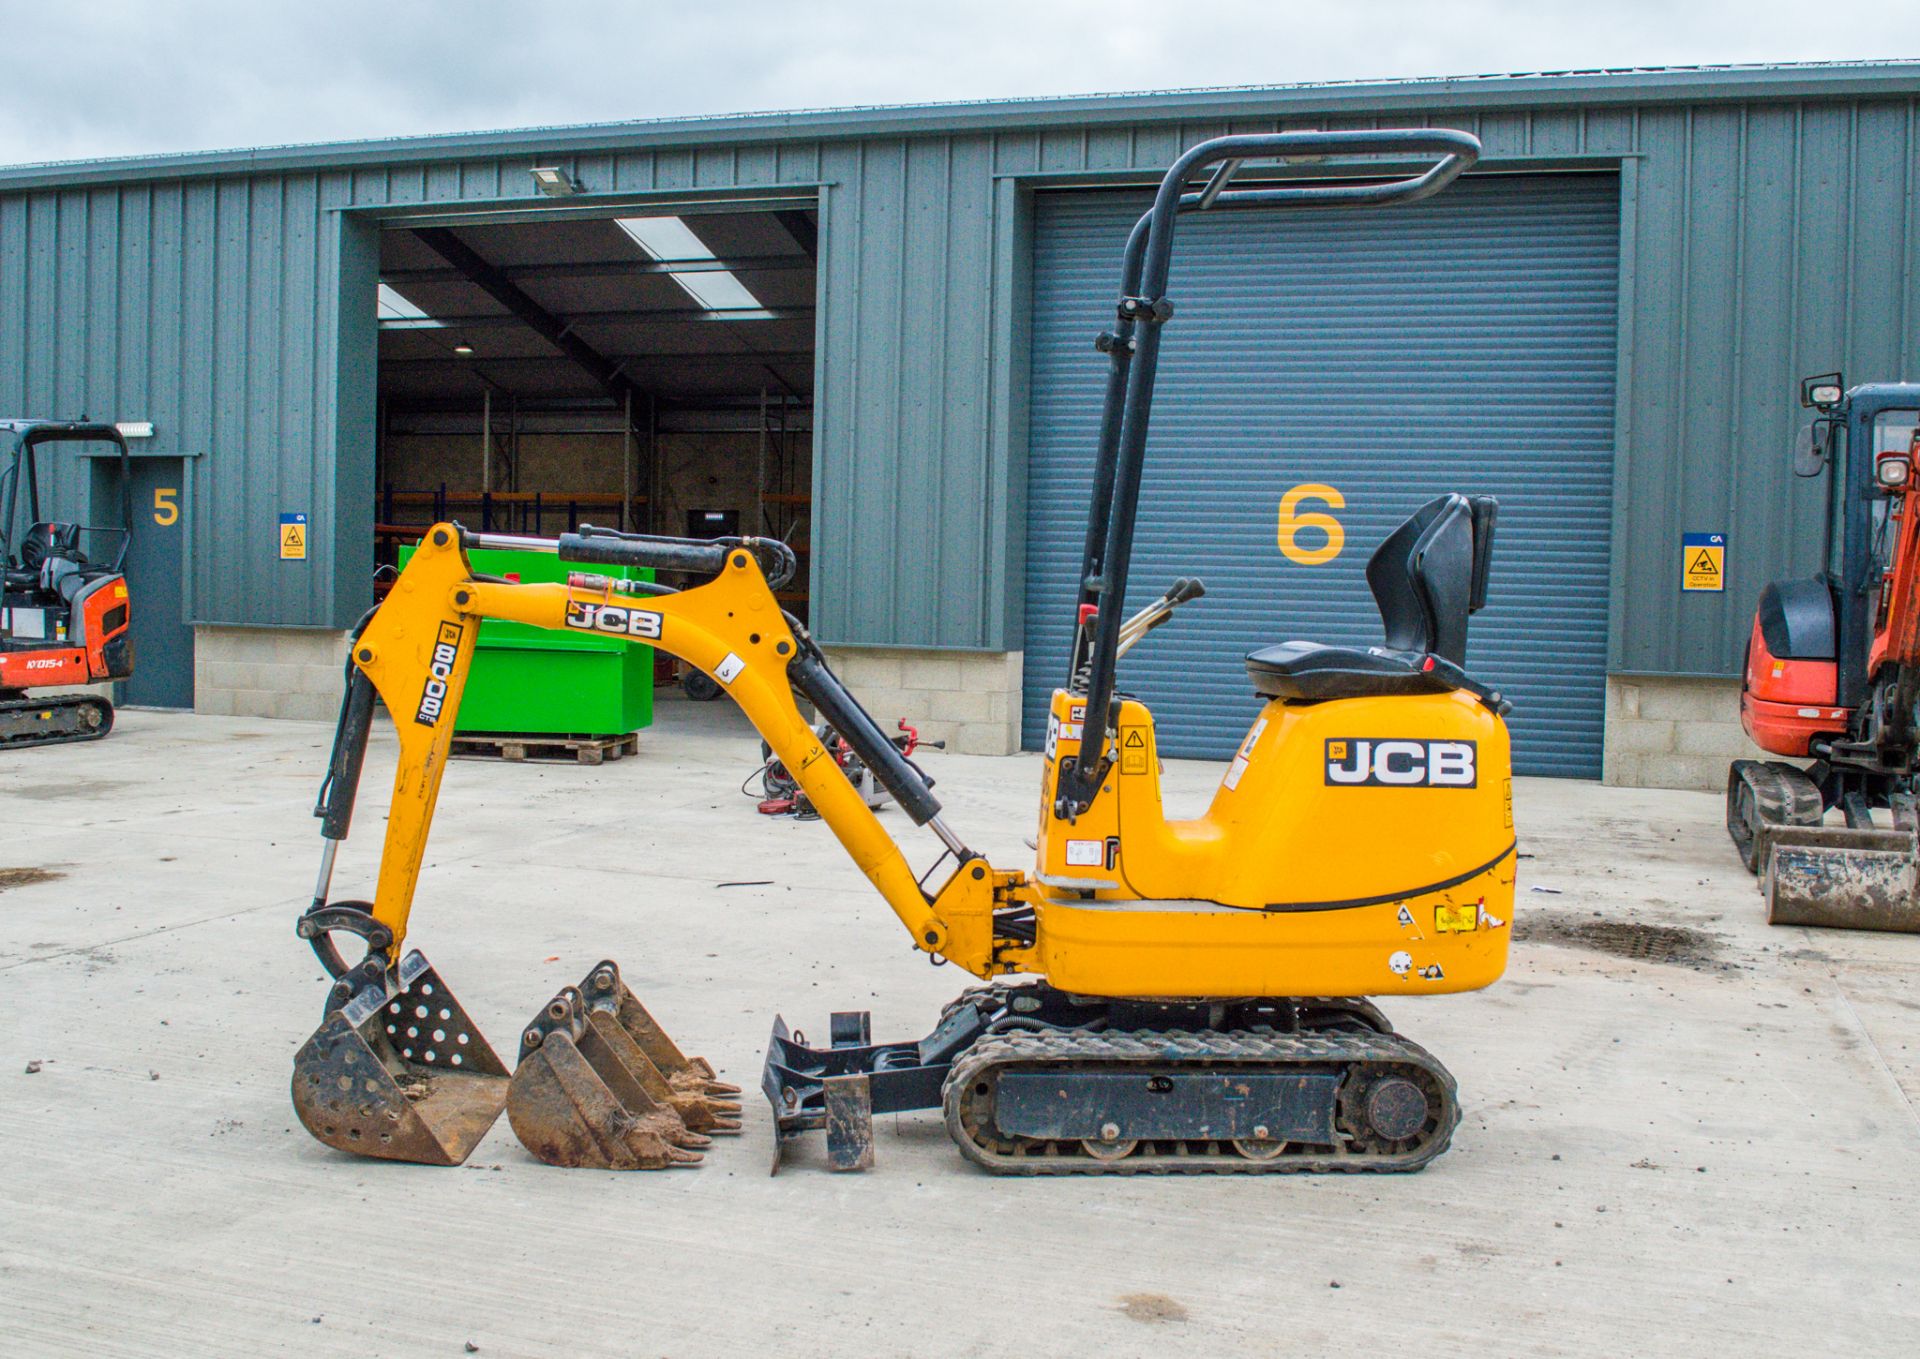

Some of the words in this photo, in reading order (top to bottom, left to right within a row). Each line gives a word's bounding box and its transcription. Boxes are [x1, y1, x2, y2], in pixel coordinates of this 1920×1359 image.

[154, 488, 178, 526] 5
[1277, 483, 1346, 566] 6
[567, 604, 661, 638] JCB
[420, 643, 457, 717] 8008
[1328, 741, 1475, 785] JCB
